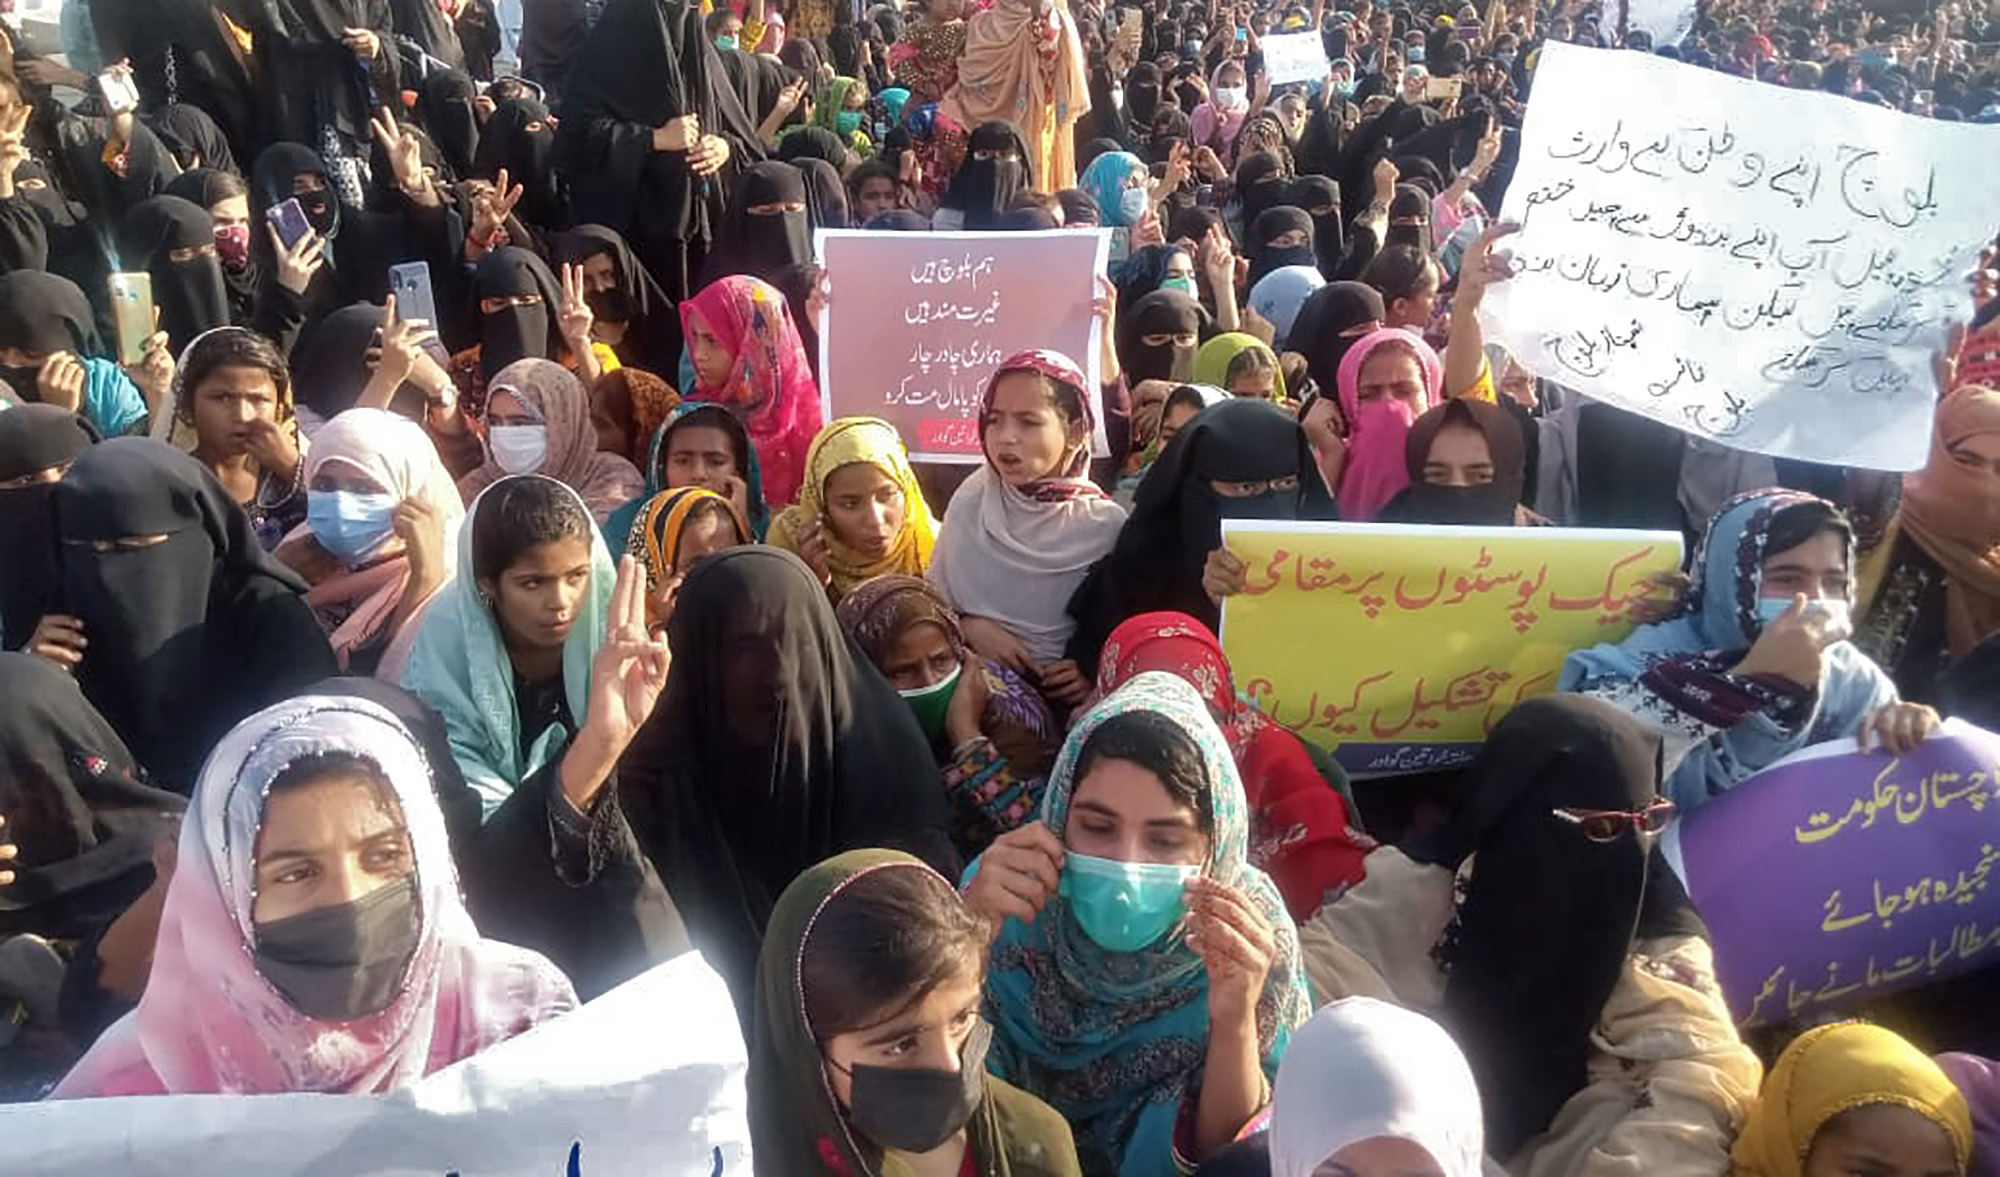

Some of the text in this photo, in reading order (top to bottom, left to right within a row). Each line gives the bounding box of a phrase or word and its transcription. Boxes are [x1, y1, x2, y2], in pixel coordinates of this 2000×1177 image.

[1547, 119, 1631, 174] وارث
[1836, 144, 1938, 228] بلوچ
[911, 253, 994, 292] ہم بلوچ ہیں
[905, 290, 1001, 324] غیرت مند ہیں
[908, 341, 1001, 374] ہماری چادر چار
[885, 375, 913, 406] کرو
[904, 389, 937, 406] مت
[938, 384, 969, 418] پامال
[1240, 548, 1352, 597] مقامی
[1346, 569, 1388, 619] پر
[1394, 545, 1548, 633] پوسٹوں
[1794, 757, 1899, 843] حکومت
